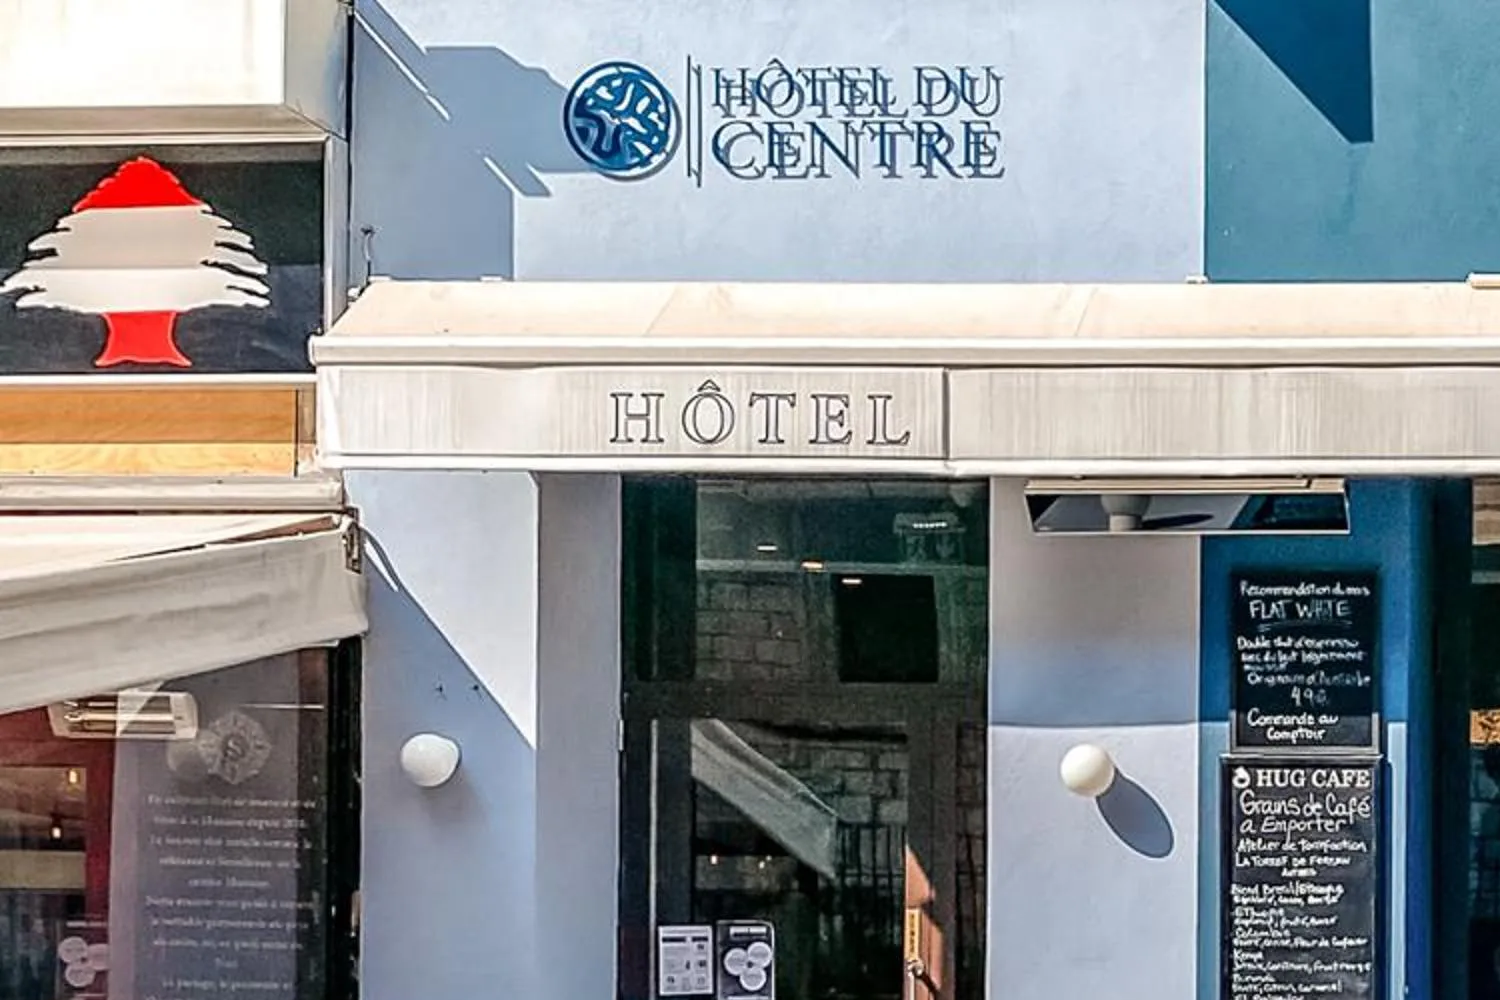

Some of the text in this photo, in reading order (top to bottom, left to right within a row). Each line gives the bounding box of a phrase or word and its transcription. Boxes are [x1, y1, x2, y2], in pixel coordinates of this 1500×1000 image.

[712, 58, 998, 110] HÔTEL DU
[712, 120, 996, 170] CENTRE
[609, 379, 911, 446] HÔTEL
[1249, 599, 1293, 619] FLAT
[1247, 707, 1315, 727] Commande
[1256, 769, 1370, 787] HUG CAFE
[1239, 789, 1371, 824] Grains de Café
[1261, 815, 1346, 844] Emporter
